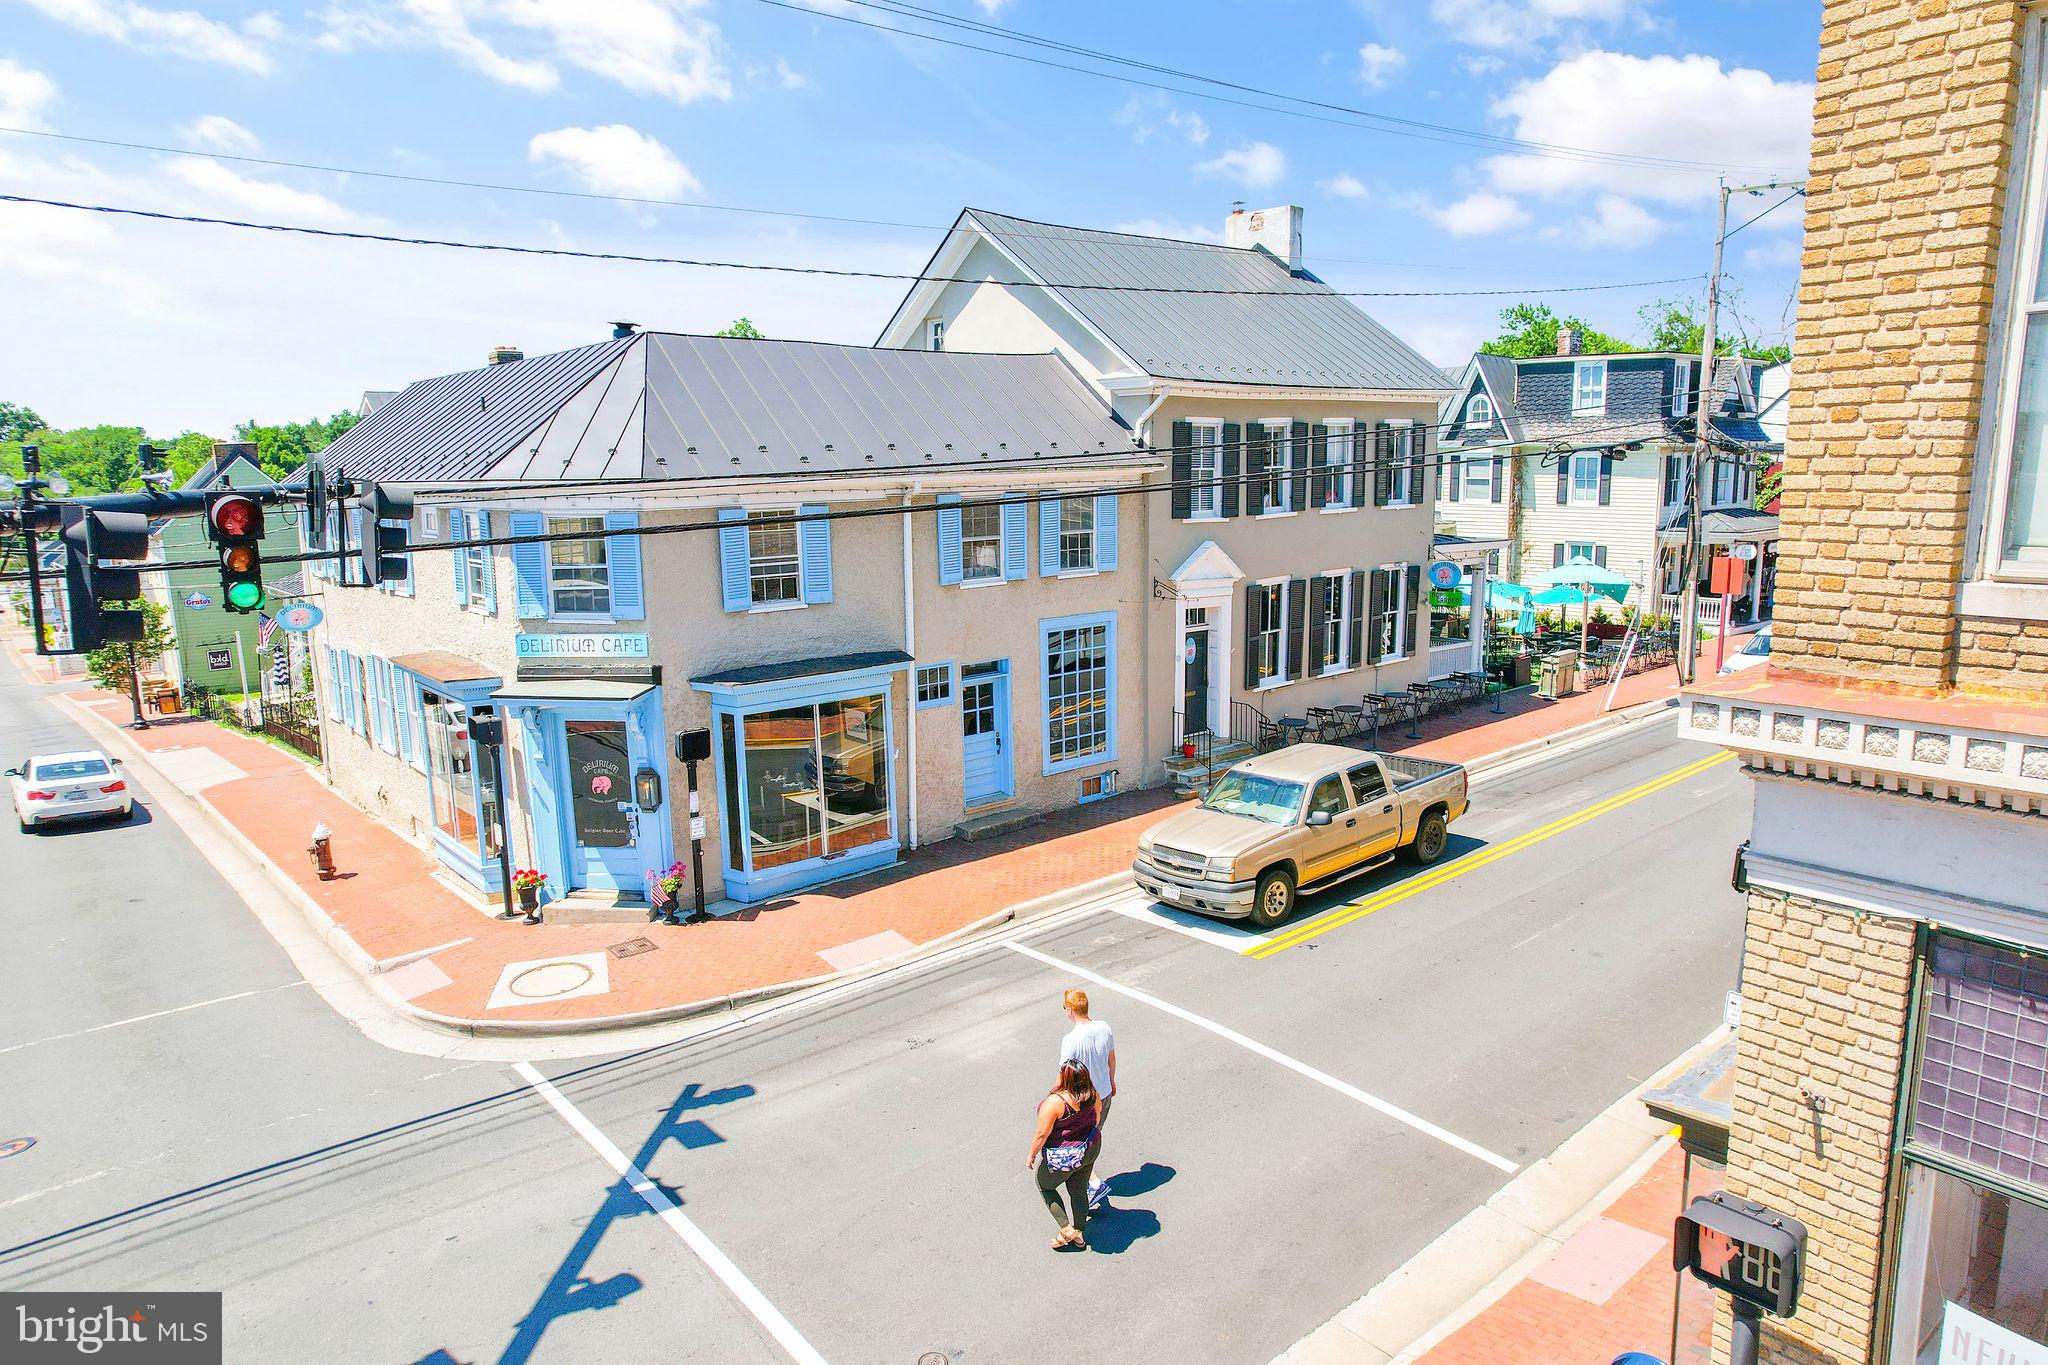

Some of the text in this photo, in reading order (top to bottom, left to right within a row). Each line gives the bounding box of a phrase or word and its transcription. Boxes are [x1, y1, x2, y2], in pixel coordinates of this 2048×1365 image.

[520, 638, 644, 653] DELIRIUM CAFE
[581, 759, 620, 774] DELIRIUM
